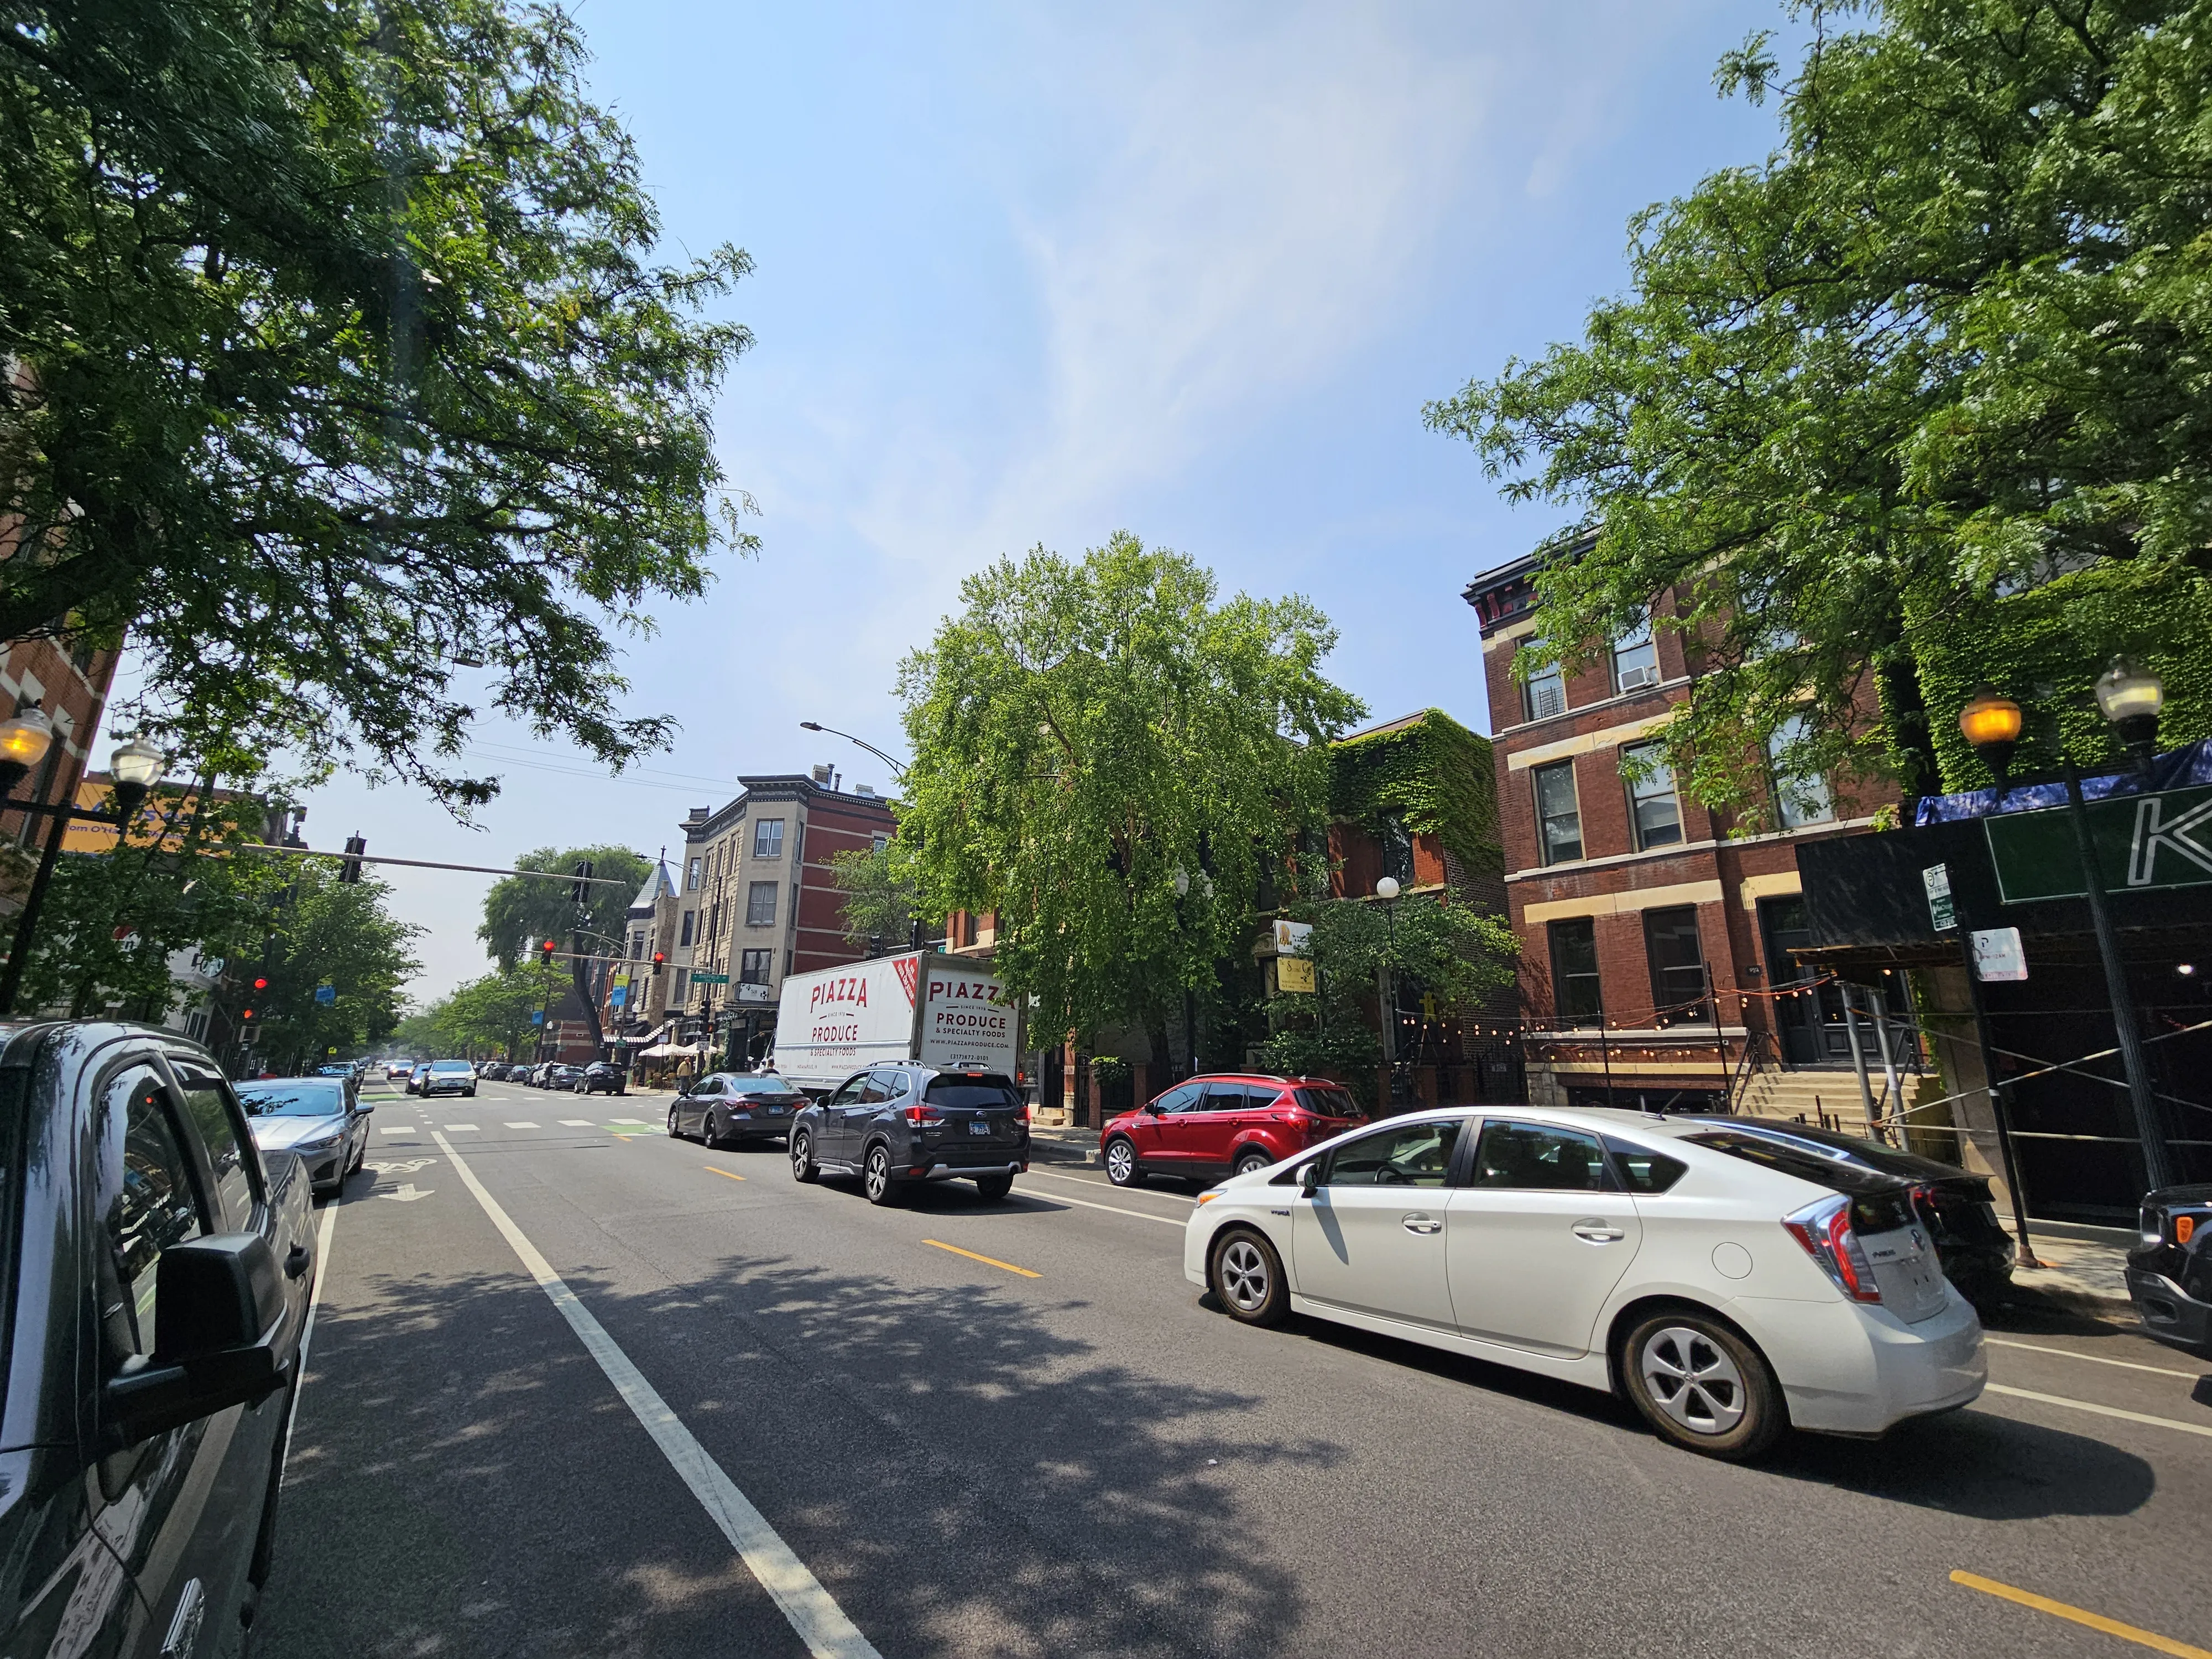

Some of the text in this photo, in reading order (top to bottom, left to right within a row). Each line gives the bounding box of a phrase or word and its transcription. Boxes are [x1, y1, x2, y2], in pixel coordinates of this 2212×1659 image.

[1287, 961, 1301, 972] Second
[810, 978, 867, 1014] PIAZZA
[929, 982, 1015, 1010] PIAZZ
[937, 1013, 1006, 1029] PRODUCE
[812, 1024, 858, 1042] PRODUCE
[943, 1027, 980, 1036] SPECIALTY
[930, 1039, 1009, 1048] WWW.PIAZZAPRODUCE.COM
[815, 1047, 838, 1056] SPECIALTY
[839, 1047, 856, 1056] FOODS
